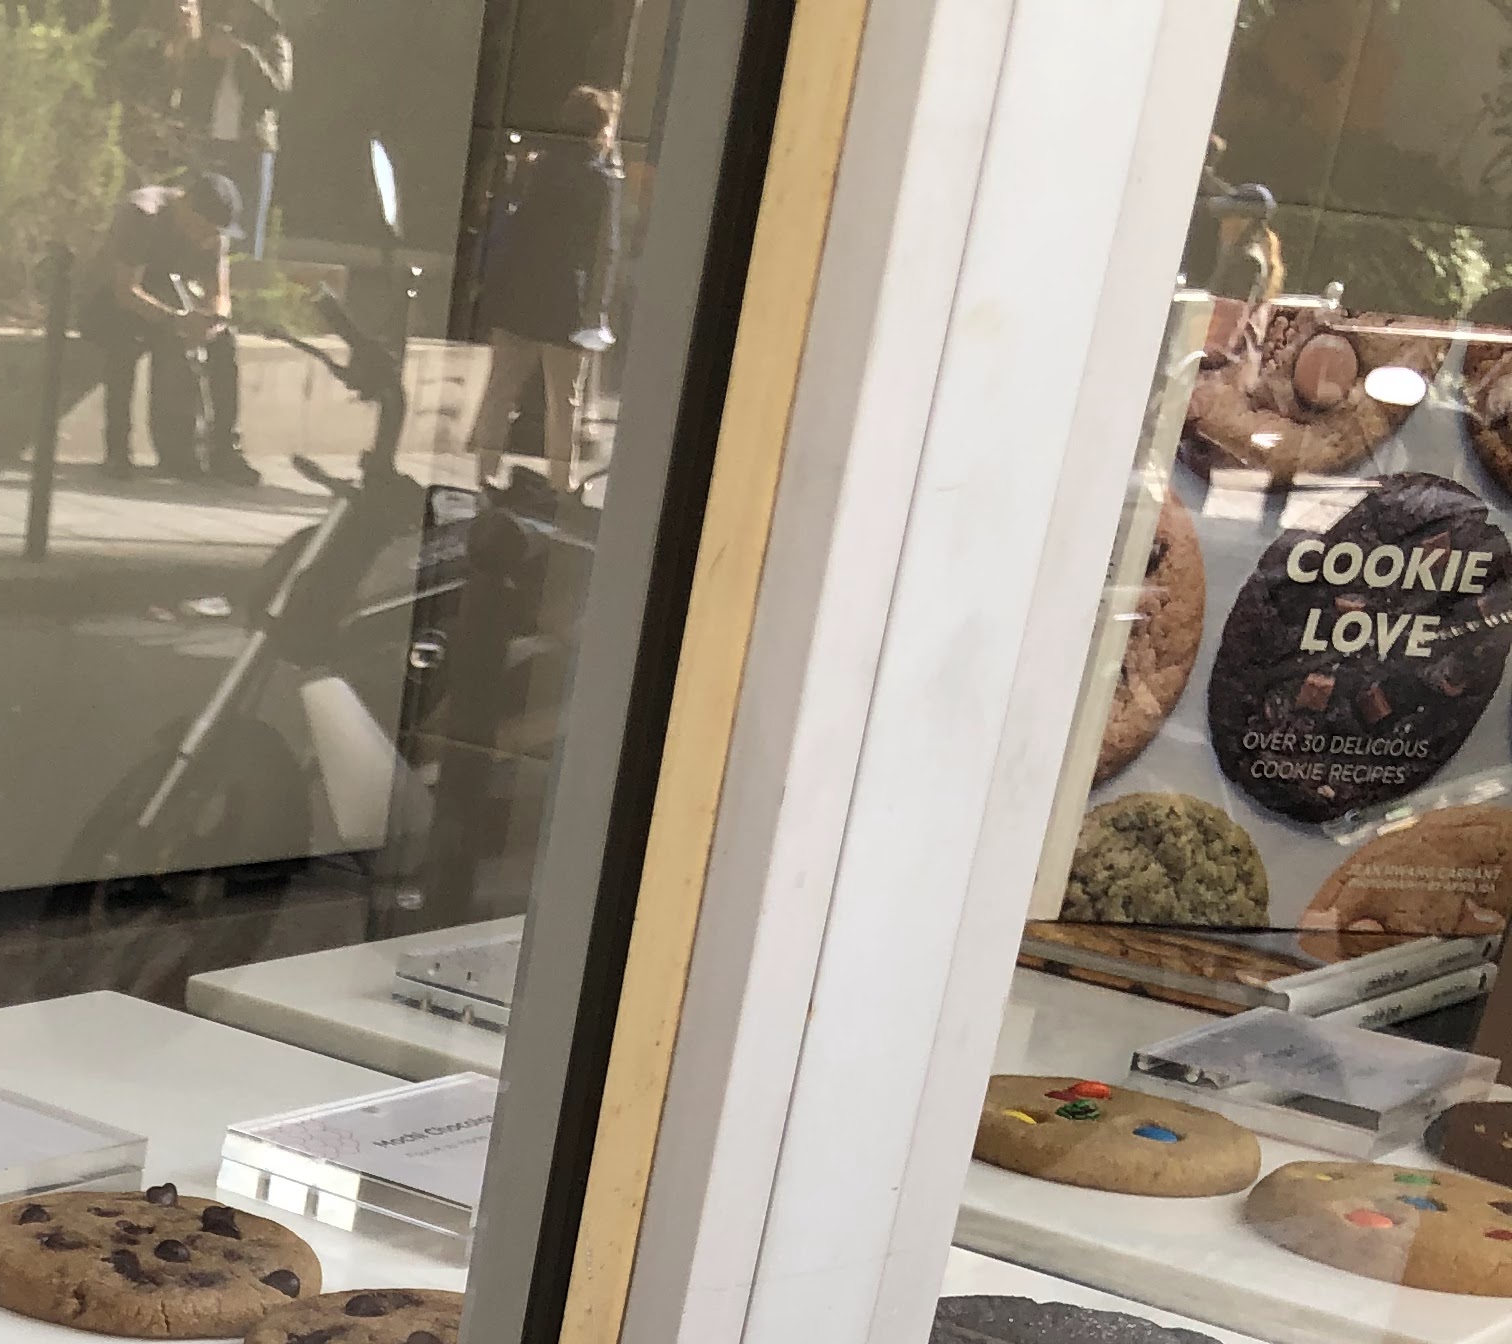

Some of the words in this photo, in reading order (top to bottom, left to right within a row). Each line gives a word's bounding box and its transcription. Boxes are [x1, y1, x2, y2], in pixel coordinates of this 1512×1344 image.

[1287, 539, 1493, 594] COOKIE
[1300, 607, 1441, 660] LOVE
[1242, 730, 1296, 752] OVER
[1300, 733, 1326, 752] 30
[1330, 735, 1429, 759] DELICIOUS
[1250, 760, 1323, 782] COOKIE
[1328, 763, 1407, 785] RECIPES
